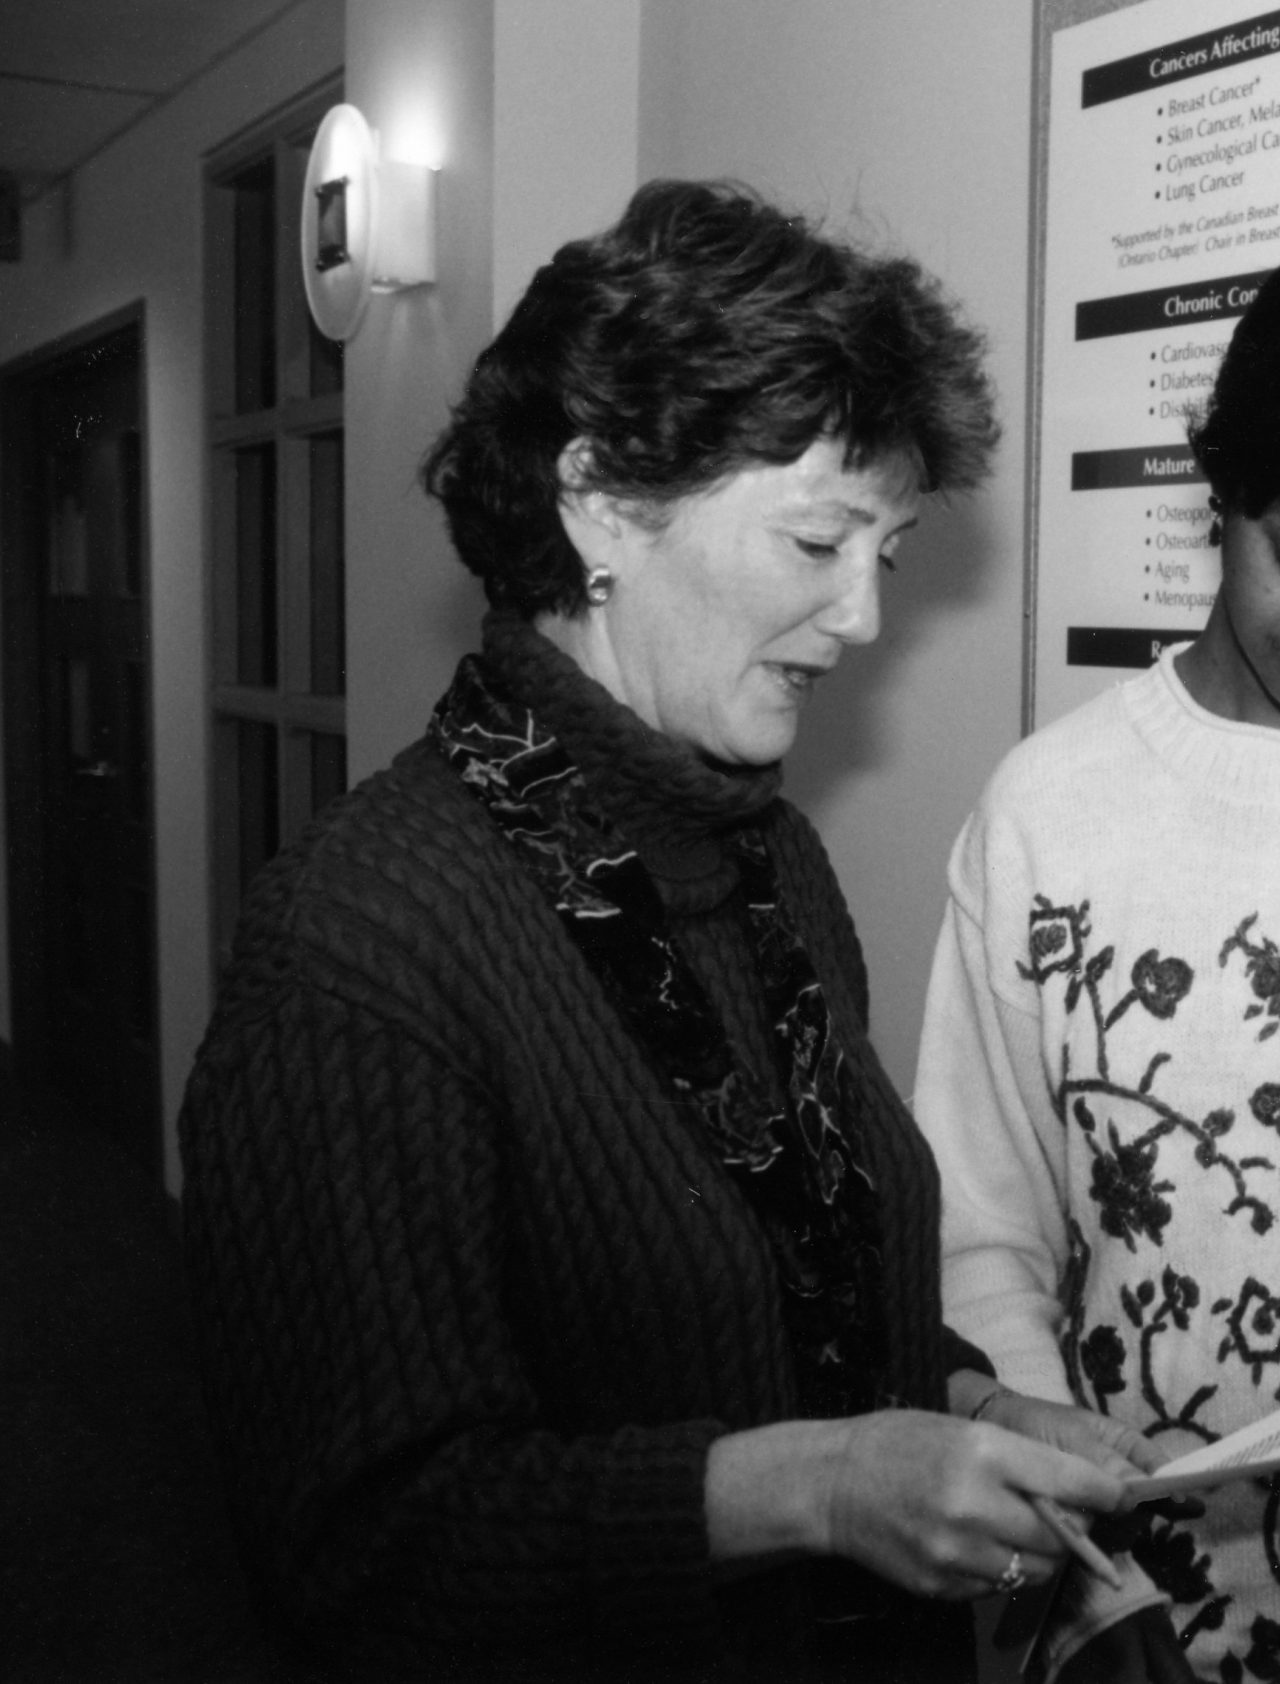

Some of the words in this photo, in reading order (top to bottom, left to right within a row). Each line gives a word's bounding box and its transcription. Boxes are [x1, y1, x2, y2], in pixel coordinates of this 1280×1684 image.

[1149, 49, 1208, 78] Cancers
[1211, 26, 1280, 61] Affecting
[1168, 94, 1205, 117] Breast
[1167, 124, 1194, 146] Skin
[1197, 114, 1245, 138] Cancer,
[1166, 133, 1257, 175] Gynecological
[1165, 182, 1196, 203] Lung
[1199, 171, 1245, 193] Cancer
[1178, 221, 1193, 236] the
[1196, 208, 1244, 232] Canadian
[1247, 203, 1280, 222] Breast
[1205, 233, 1233, 252] Chair
[1235, 231, 1246, 246] in
[1248, 226, 1280, 244] Breast
[1164, 289, 1223, 317] Chronic
[1142, 457, 1196, 476] Mature
[1155, 560, 1190, 584] Aging
